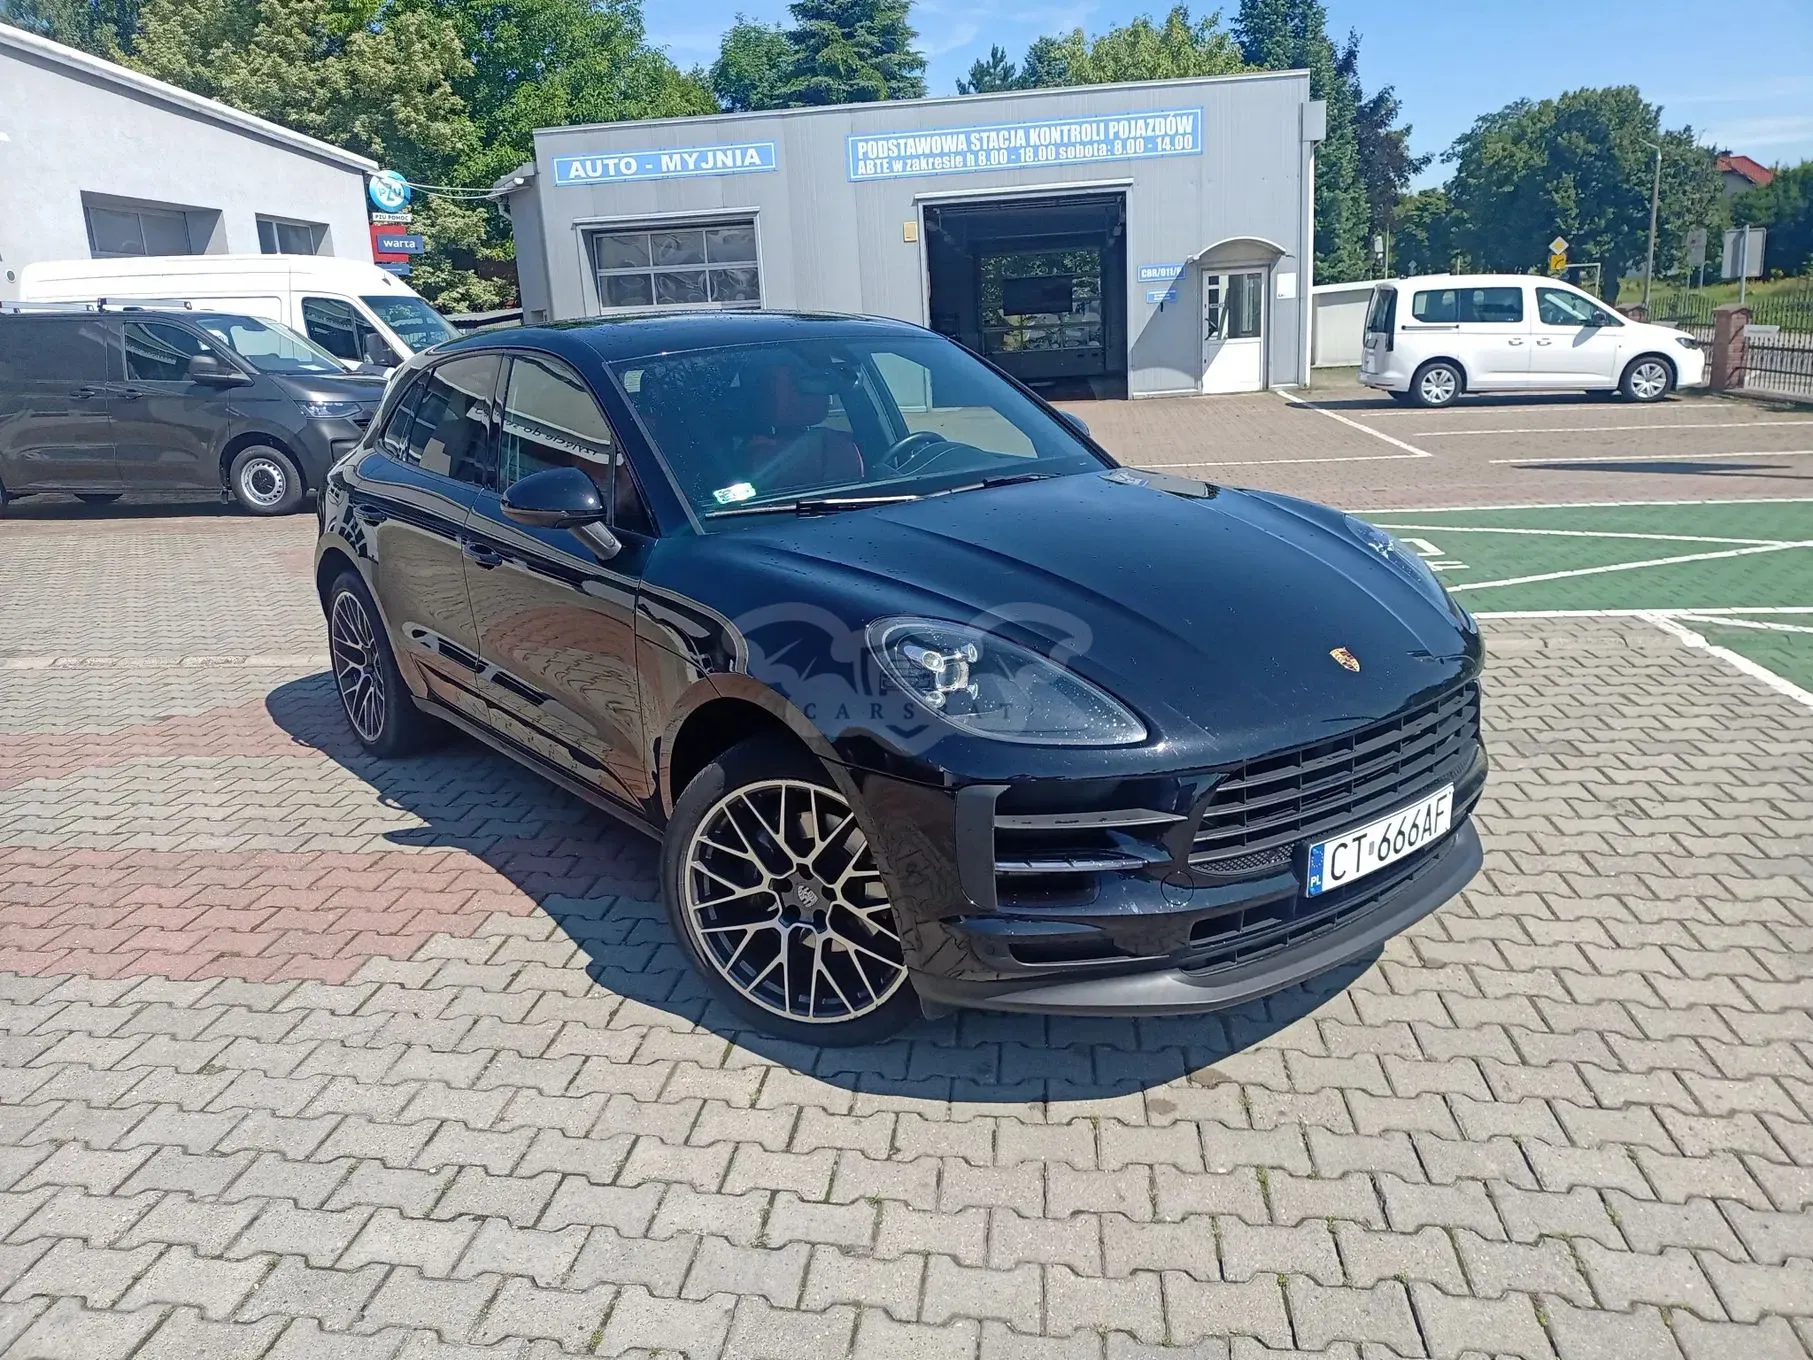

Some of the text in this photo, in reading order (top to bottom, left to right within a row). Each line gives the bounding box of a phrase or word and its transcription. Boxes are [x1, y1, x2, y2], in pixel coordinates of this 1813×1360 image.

[858, 113, 1194, 159] PODSTAWOWA STACJA KONTROLI POJAZDÓW
[568, 157, 638, 179] AUTO
[661, 148, 762, 172] MYJNIA
[858, 159, 890, 175] ABTE
[892, 160, 903, 172] w
[906, 154, 963, 172] zakresie
[967, 153, 975, 167] h
[978, 149, 1008, 166] 8.00
[1018, 145, 1055, 163] 18.00
[1059, 142, 1111, 159] sobota:
[1114, 138, 1144, 155] 8.00
[1156, 135, 1193, 152] 14.00
[383, 239, 416, 248] warta
[1331, 794, 1448, 881] CT 666AF
[1310, 875, 1321, 888] PL
